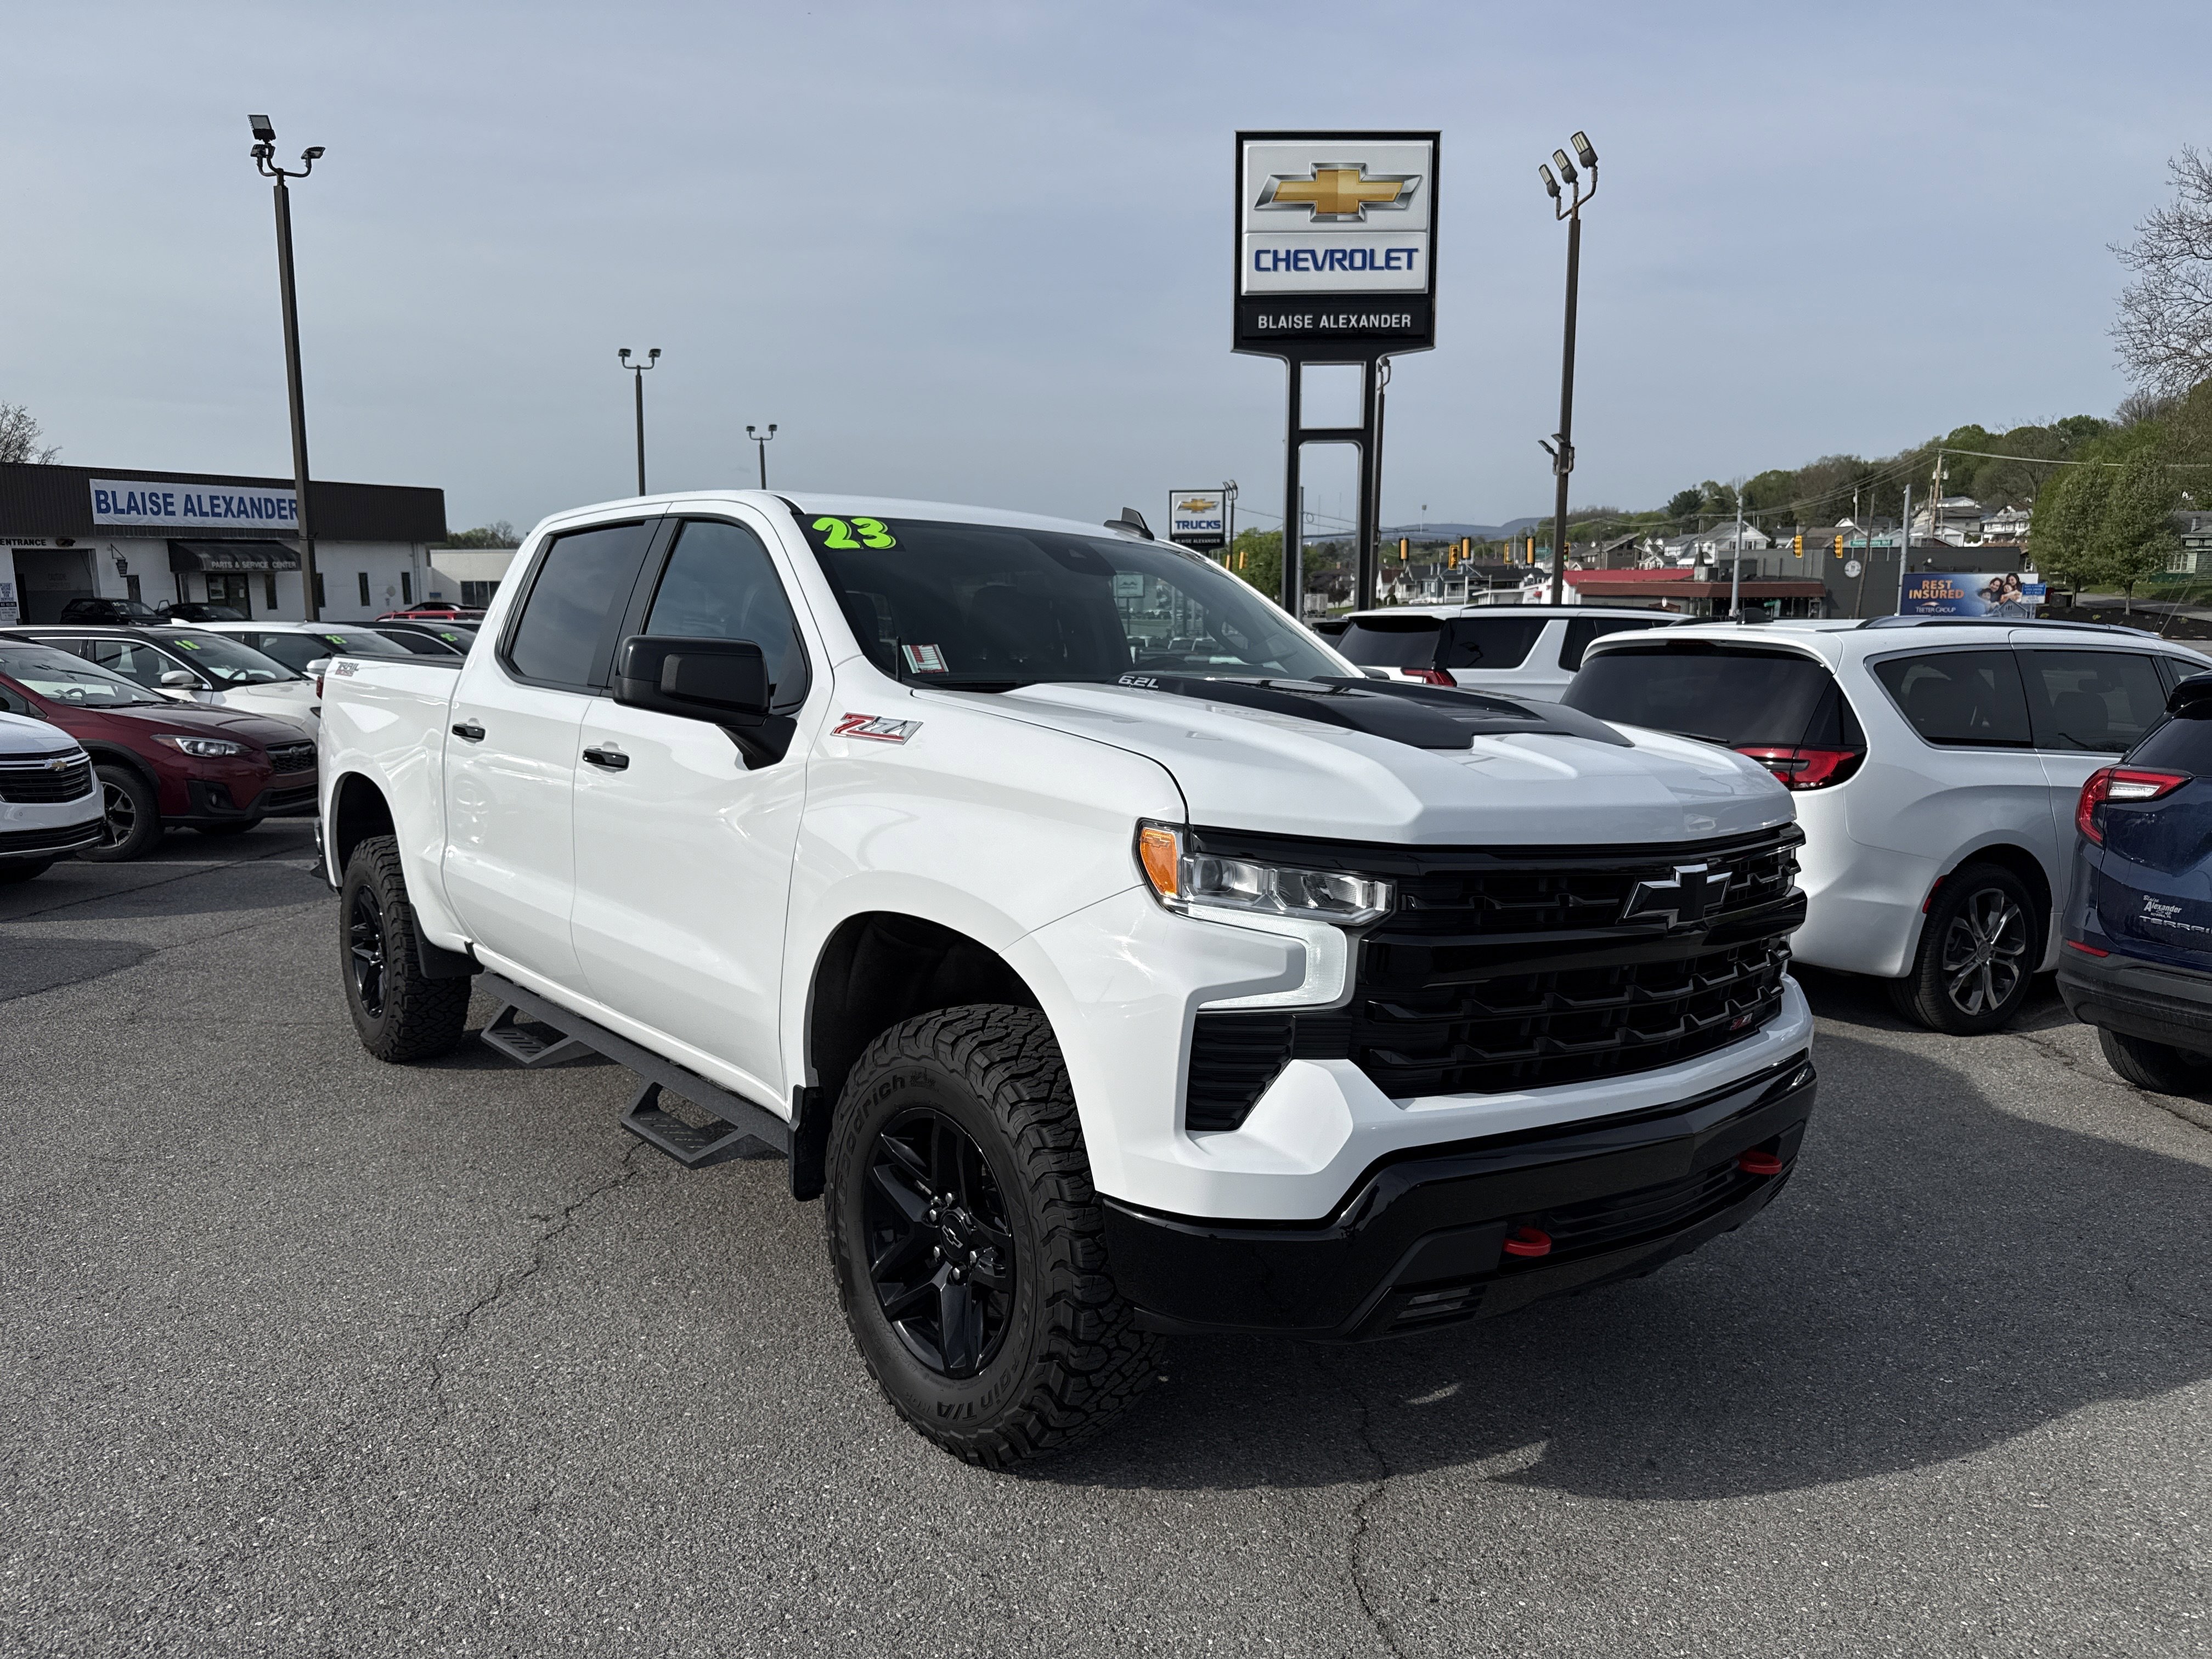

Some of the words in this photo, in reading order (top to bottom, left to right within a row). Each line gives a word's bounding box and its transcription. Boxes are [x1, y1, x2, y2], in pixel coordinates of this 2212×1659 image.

[1255, 249, 1419, 272] CHEVROLET
[1258, 314, 1313, 329] BLAISE
[1319, 314, 1412, 328] ALEXANDER
[94, 489, 176, 516] BLAISE
[183, 494, 298, 521] ALEXANDER
[1175, 520, 1221, 529] TRUCKS
[812, 517, 896, 549] 23
[272, 561, 297, 569] CENTER
[1922, 579, 1953, 590] REST
[1909, 589, 1965, 600] INSURED
[337, 661, 360, 671] TRAIL
[335, 669, 355, 678] BOSS
[1118, 675, 1159, 689] 6.2L
[830, 712, 924, 745] Z71
[2143, 901, 2182, 913] Alexander
[2139, 916, 2212, 934] TERRAI
[837, 1074, 906, 1260] BFGoodrich
[936, 1401, 978, 1421] T/A
